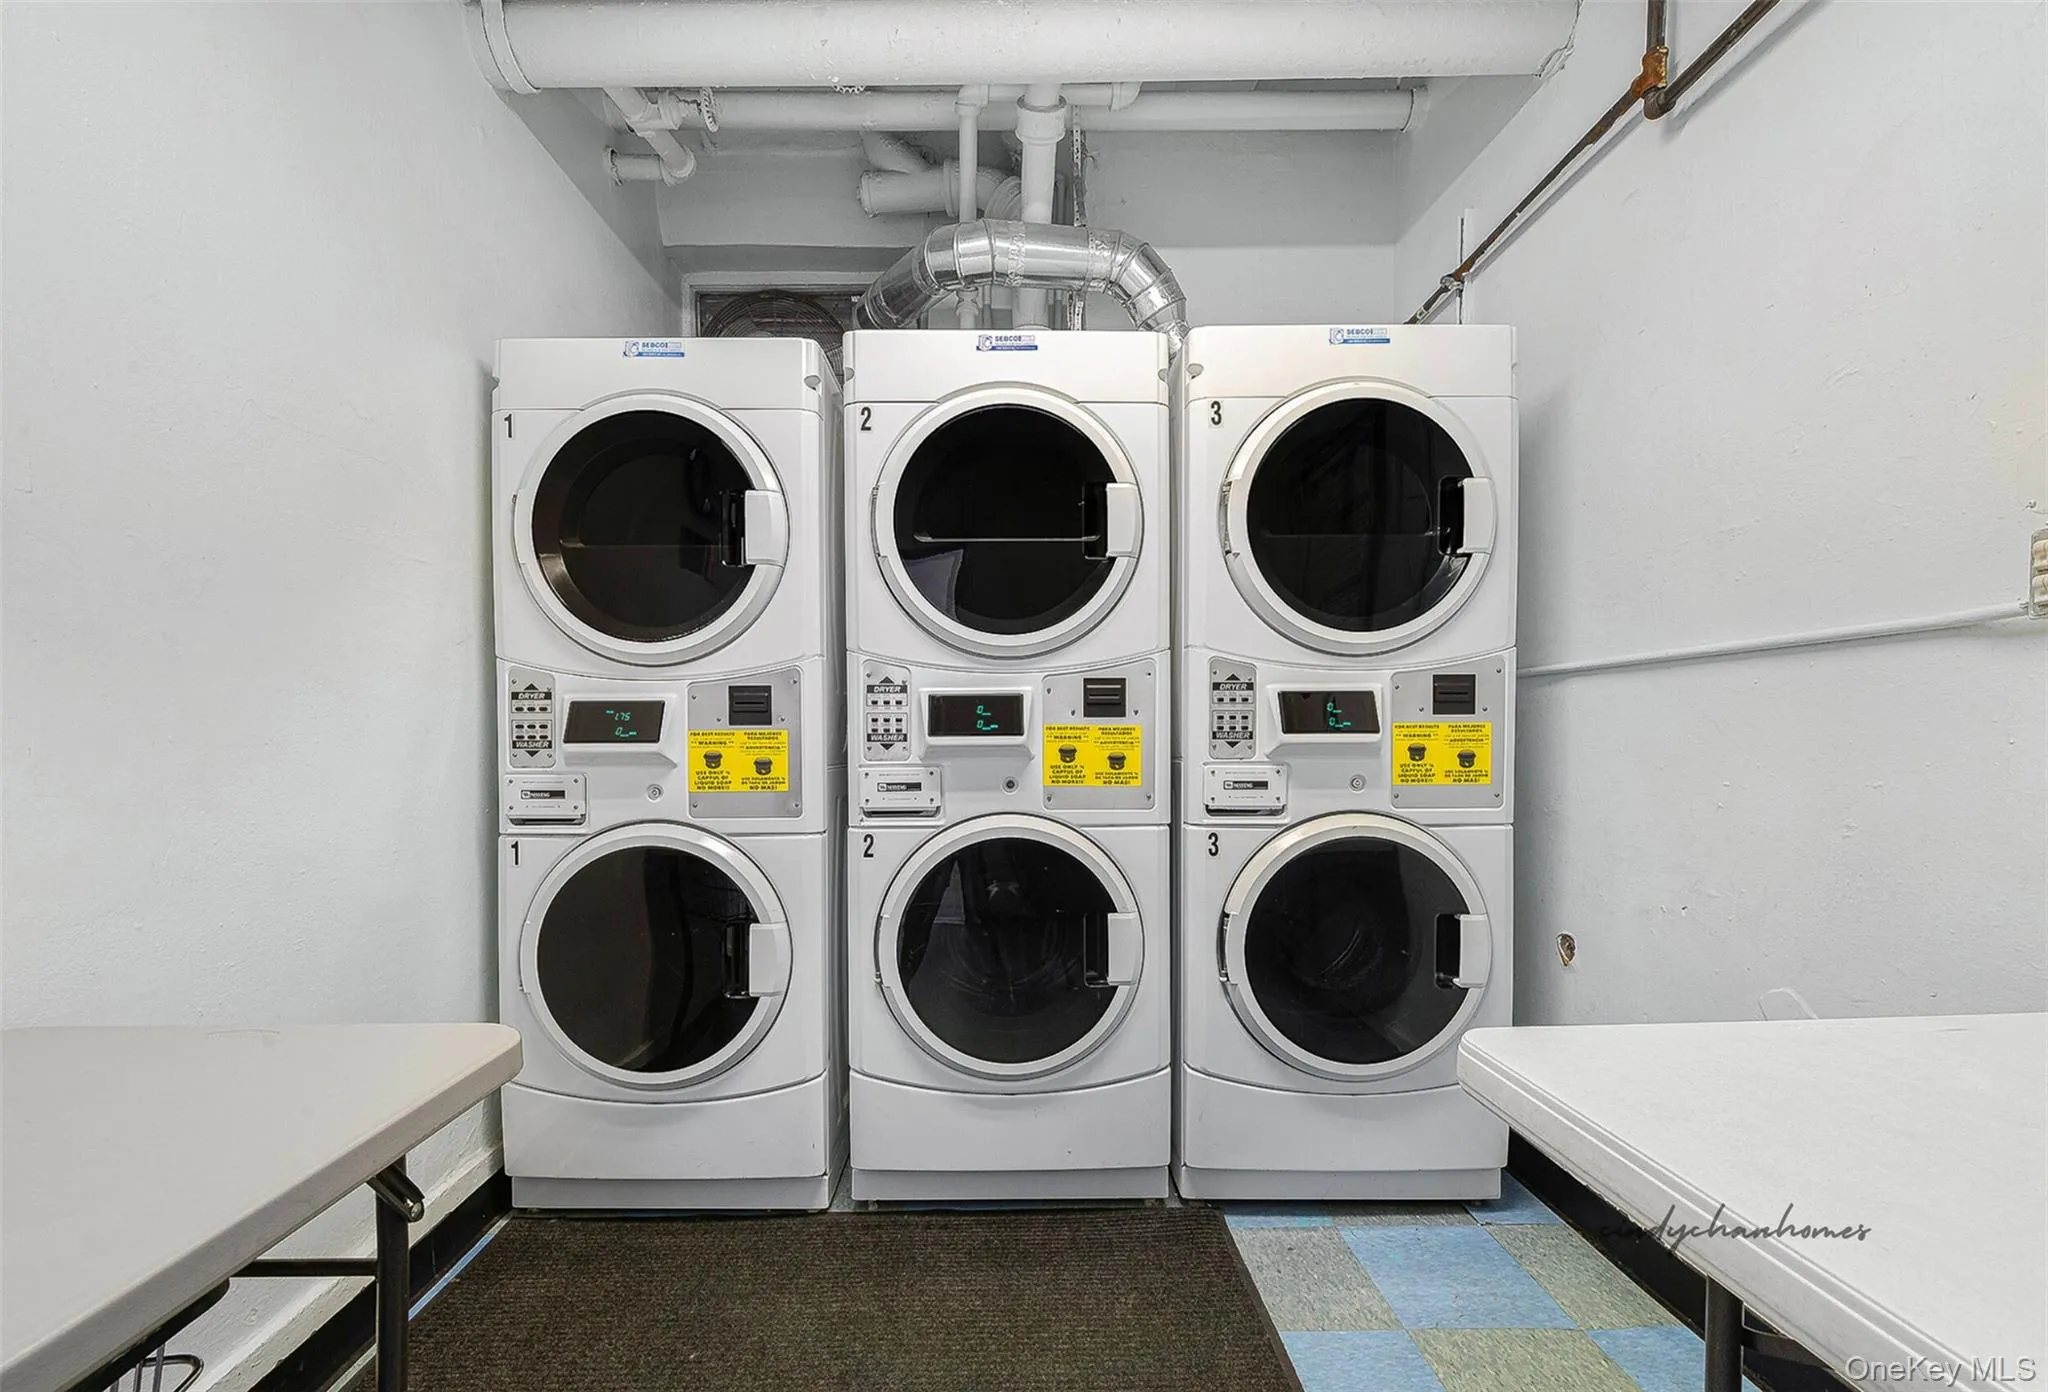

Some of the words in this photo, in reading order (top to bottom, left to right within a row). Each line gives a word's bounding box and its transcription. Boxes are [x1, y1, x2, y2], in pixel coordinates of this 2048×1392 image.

[504, 413, 512, 438] 1
[861, 406, 871, 431] 2
[1211, 401, 1222, 425] 3
[511, 840, 519, 866] 1
[863, 833, 874, 858] 2
[1208, 832, 1219, 857] 3
